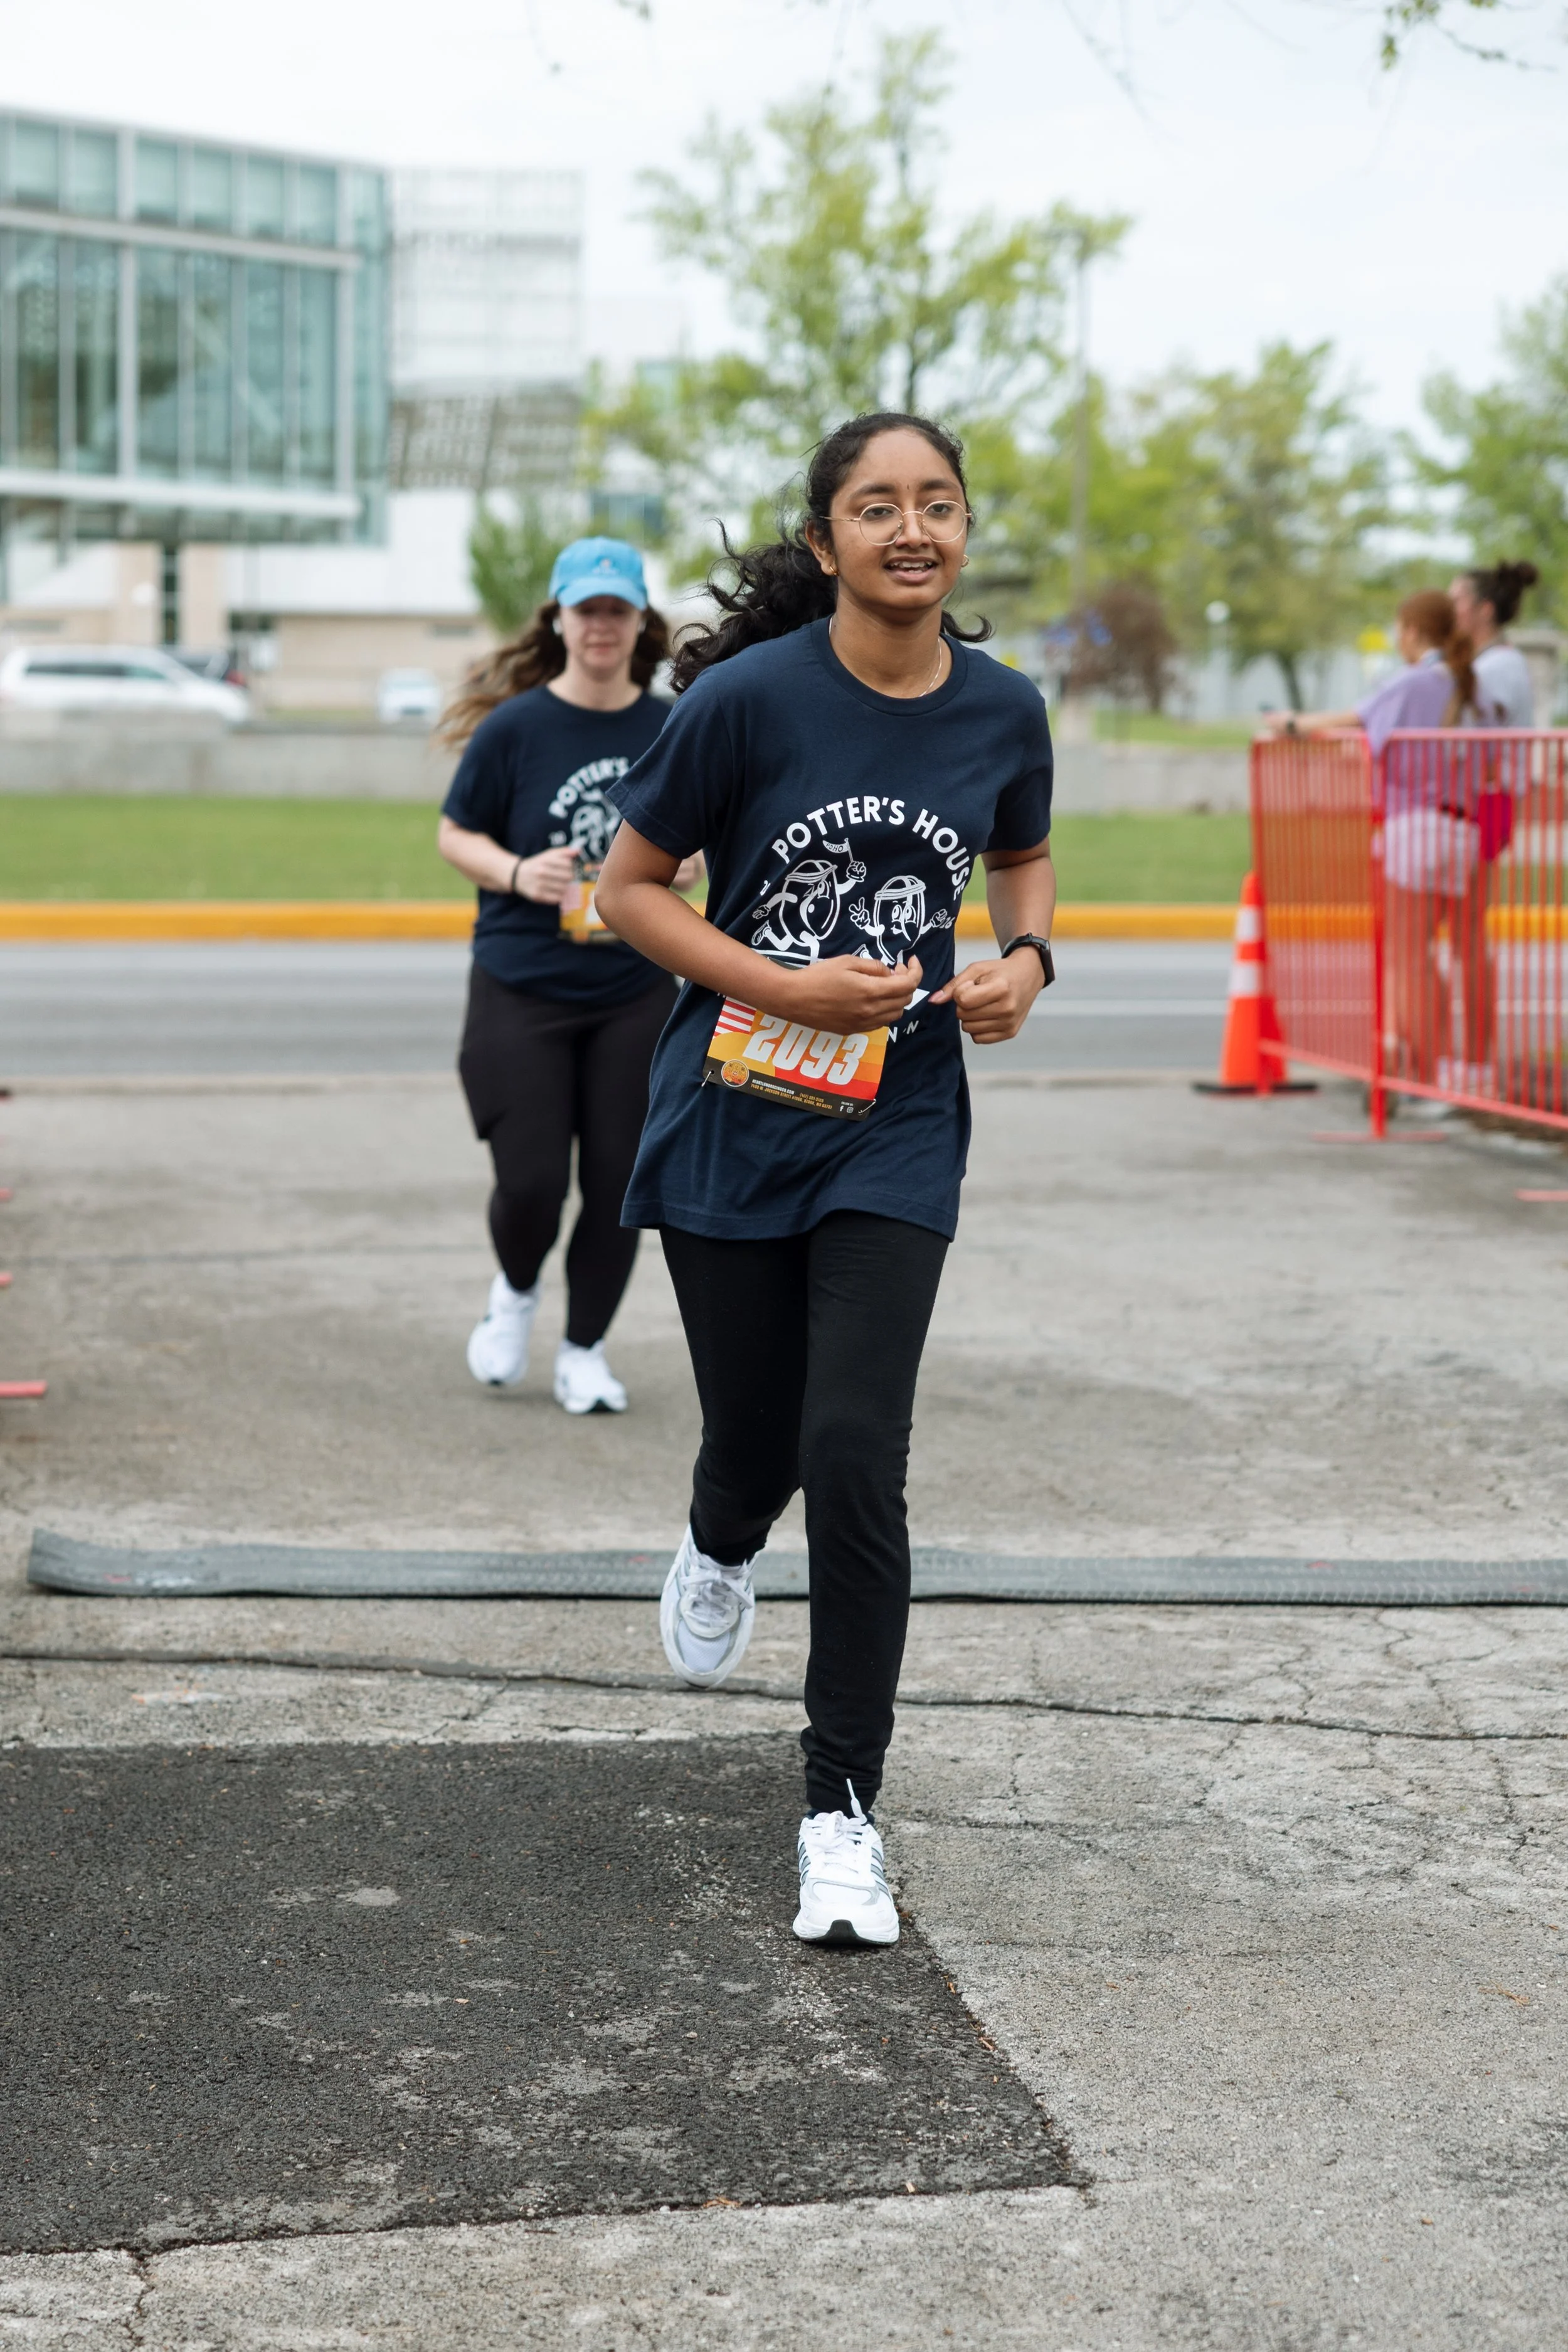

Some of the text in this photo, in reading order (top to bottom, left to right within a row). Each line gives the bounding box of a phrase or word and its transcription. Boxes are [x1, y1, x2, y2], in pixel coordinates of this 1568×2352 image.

[771, 795, 906, 865] POTTER'S
[825, 843, 844, 852] POHO
[742, 1013, 869, 1086] 2093
